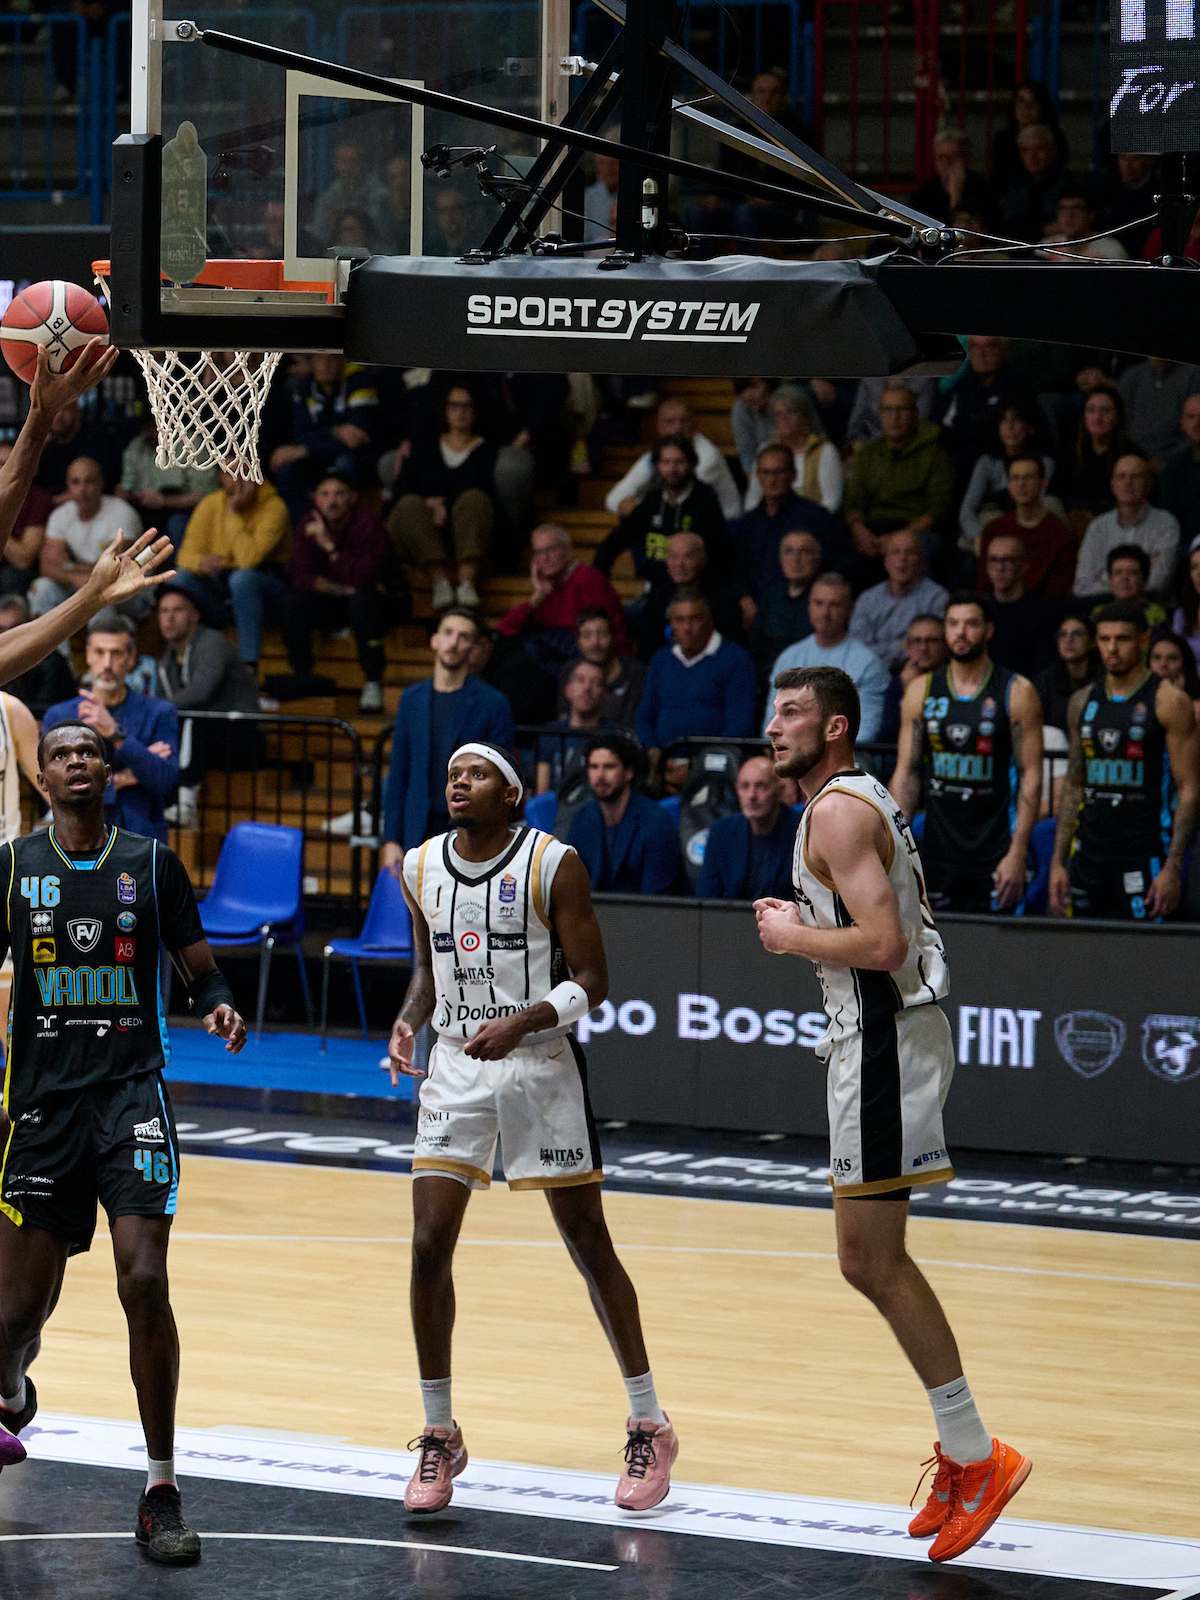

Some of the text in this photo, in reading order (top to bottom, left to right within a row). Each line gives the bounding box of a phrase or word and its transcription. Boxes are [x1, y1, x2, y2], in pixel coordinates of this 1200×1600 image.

[467, 295, 760, 341] SPORTSYSTEM
[924, 696, 950, 719] 23
[21, 875, 60, 908] 46
[34, 966, 139, 1006] VANOLI
[677, 993, 828, 1049] Boss
[958, 1005, 1043, 1069] FIAT
[134, 1149, 169, 1184] 46
[555, 1148, 584, 1161] ITAS
